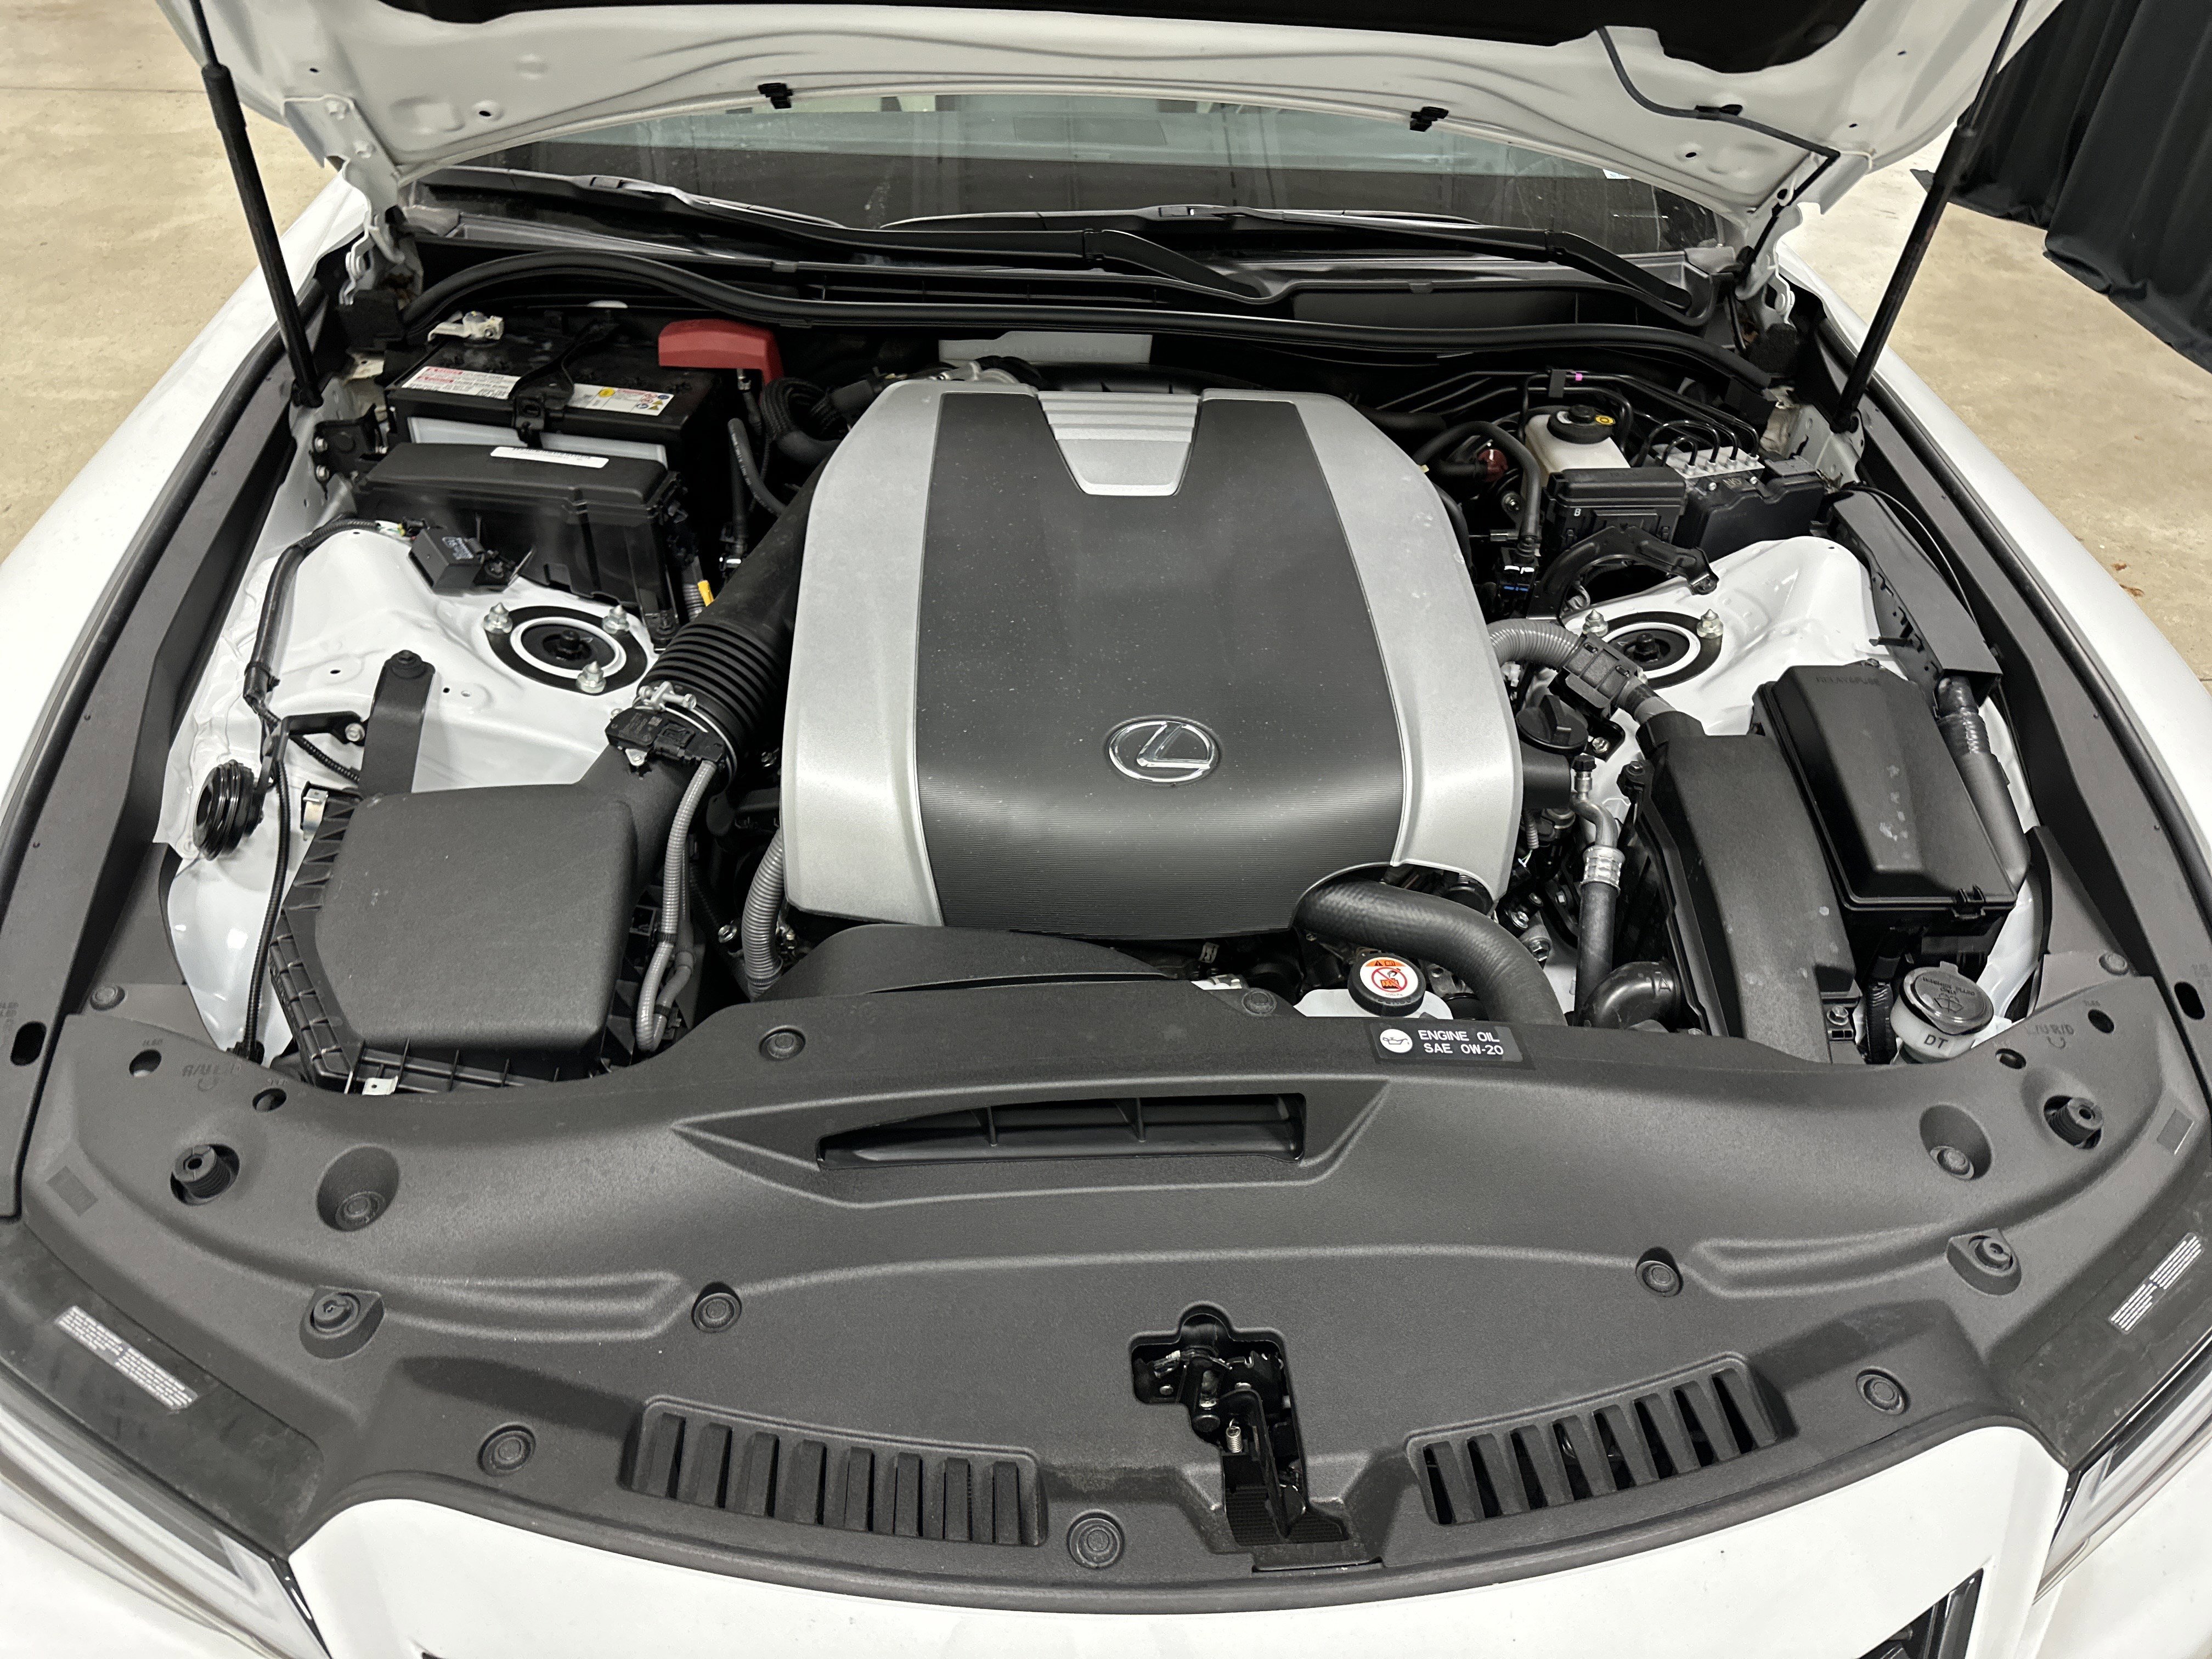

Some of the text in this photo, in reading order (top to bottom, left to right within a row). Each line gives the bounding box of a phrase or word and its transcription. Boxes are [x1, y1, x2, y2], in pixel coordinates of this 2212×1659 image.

[1418, 1030, 1500, 1042] ENGINE OIL
[1924, 1034, 1948, 1048] DT
[1424, 1043, 1504, 1055] SAE 0W-20
